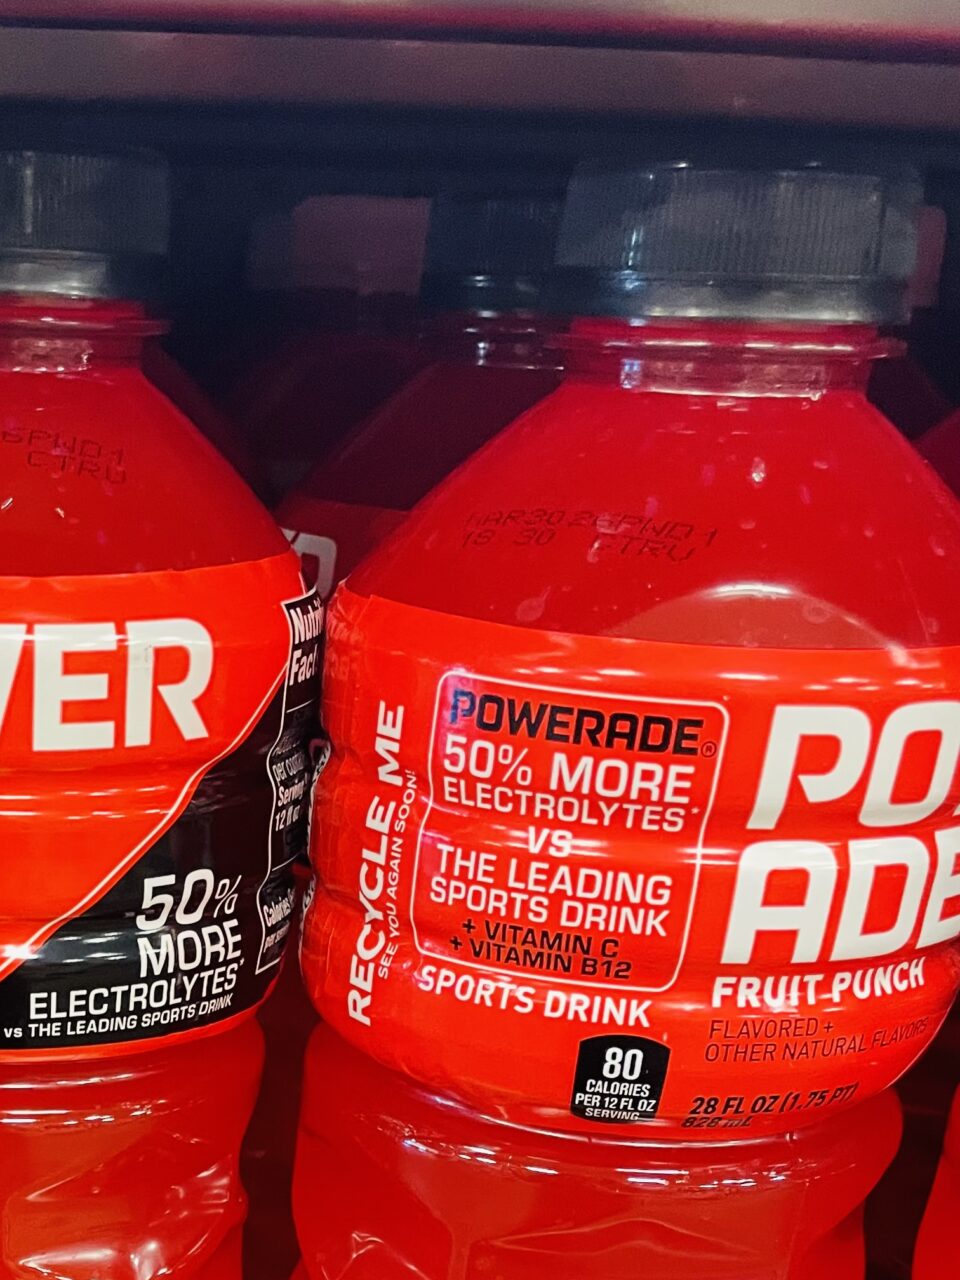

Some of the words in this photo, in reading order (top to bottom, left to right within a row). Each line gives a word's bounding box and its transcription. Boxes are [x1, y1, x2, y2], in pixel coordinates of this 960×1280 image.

[443, 734, 532, 786] 50%
[550, 752, 696, 804] MORE
[396, 768, 417, 834] SOON!
[347, 795, 397, 1027] RECYCLE
[374, 700, 405, 787] ME
[528, 825, 573, 858] VS
[389, 836, 403, 900] AGAIN
[437, 843, 497, 884] THE
[507, 858, 672, 905] LEADING
[136, 869, 242, 931] 50%
[389, 902, 401, 938] YOU
[430, 876, 549, 923] SPORTS
[560, 900, 670, 937] DRINK
[137, 918, 242, 978] MORE
[378, 943, 398, 980] SEE
[469, 938, 571, 973] VITAMIN
[581, 957, 632, 979] B12
[485, 920, 592, 955] VITAMIN
[601, 938, 620, 958] C
[418, 964, 536, 1014] SPORTS
[543, 990, 653, 1028] DRINK
[711, 973, 824, 1008] FRUIT
[832, 956, 926, 1003] PUNCH
[28, 1022, 61, 1038] THE
[66, 1014, 137, 1036] LEADING
[141, 1004, 195, 1027] SPORTS
[198, 993, 233, 1016] DRINK
[709, 1017, 818, 1040] FLAVORED
[705, 1043, 775, 1062] OTHER
[782, 1034, 866, 1060] NATURAL
[871, 1017, 930, 1049] FLAVORS
[602, 1047, 643, 1080] 80
[575, 1093, 601, 1107] PER
[604, 1096, 618, 1109] 12
[620, 1098, 634, 1111] FL
[637, 1099, 656, 1112] OZ
[586, 1079, 651, 1097] CALORIES
[690, 1096, 719, 1115] 28
[722, 1097, 745, 1115] FL
[751, 1095, 780, 1114] OZ
[780, 1089, 828, 1114] (1.75
[831, 1082, 859, 1104] PT)
[585, 1108, 640, 1120] SERVING
